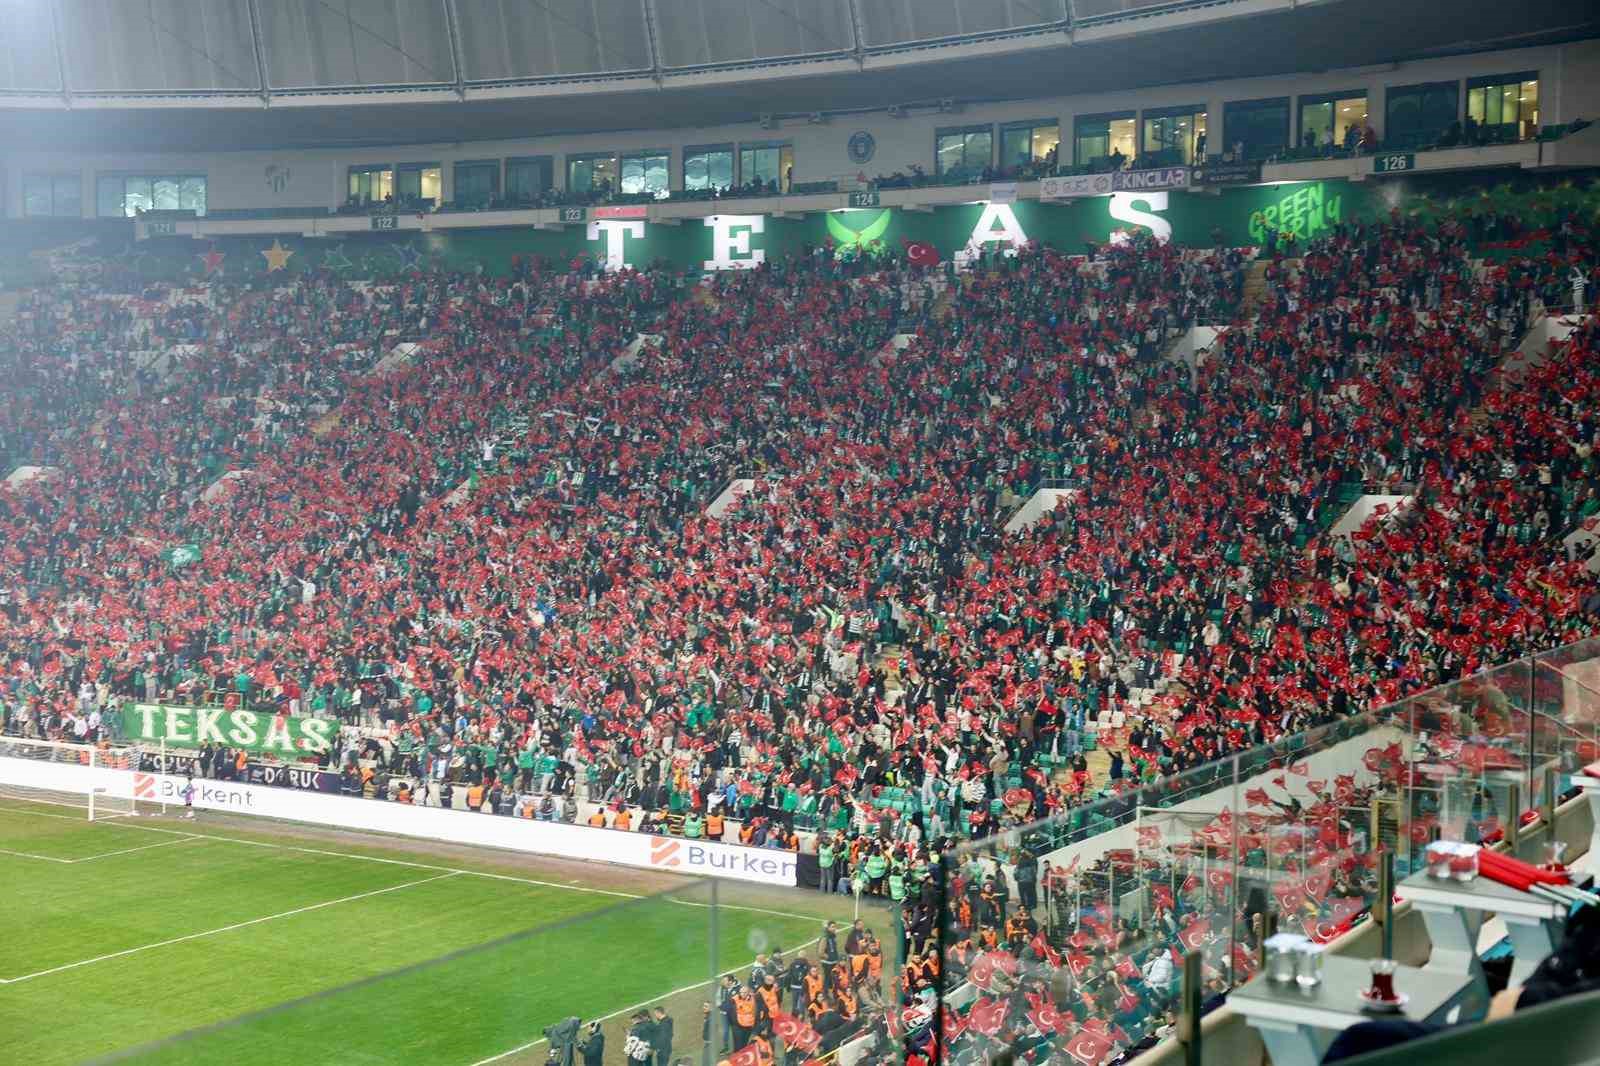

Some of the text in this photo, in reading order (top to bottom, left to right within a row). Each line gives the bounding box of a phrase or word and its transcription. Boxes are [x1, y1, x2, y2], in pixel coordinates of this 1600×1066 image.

[1382, 156, 1406, 171] 126
[855, 194, 873, 206] 124
[565, 208, 581, 220] 123
[1249, 183, 1324, 243] GREEN
[377, 217, 392, 228] 122
[134, 704, 332, 754] TEKSAS
